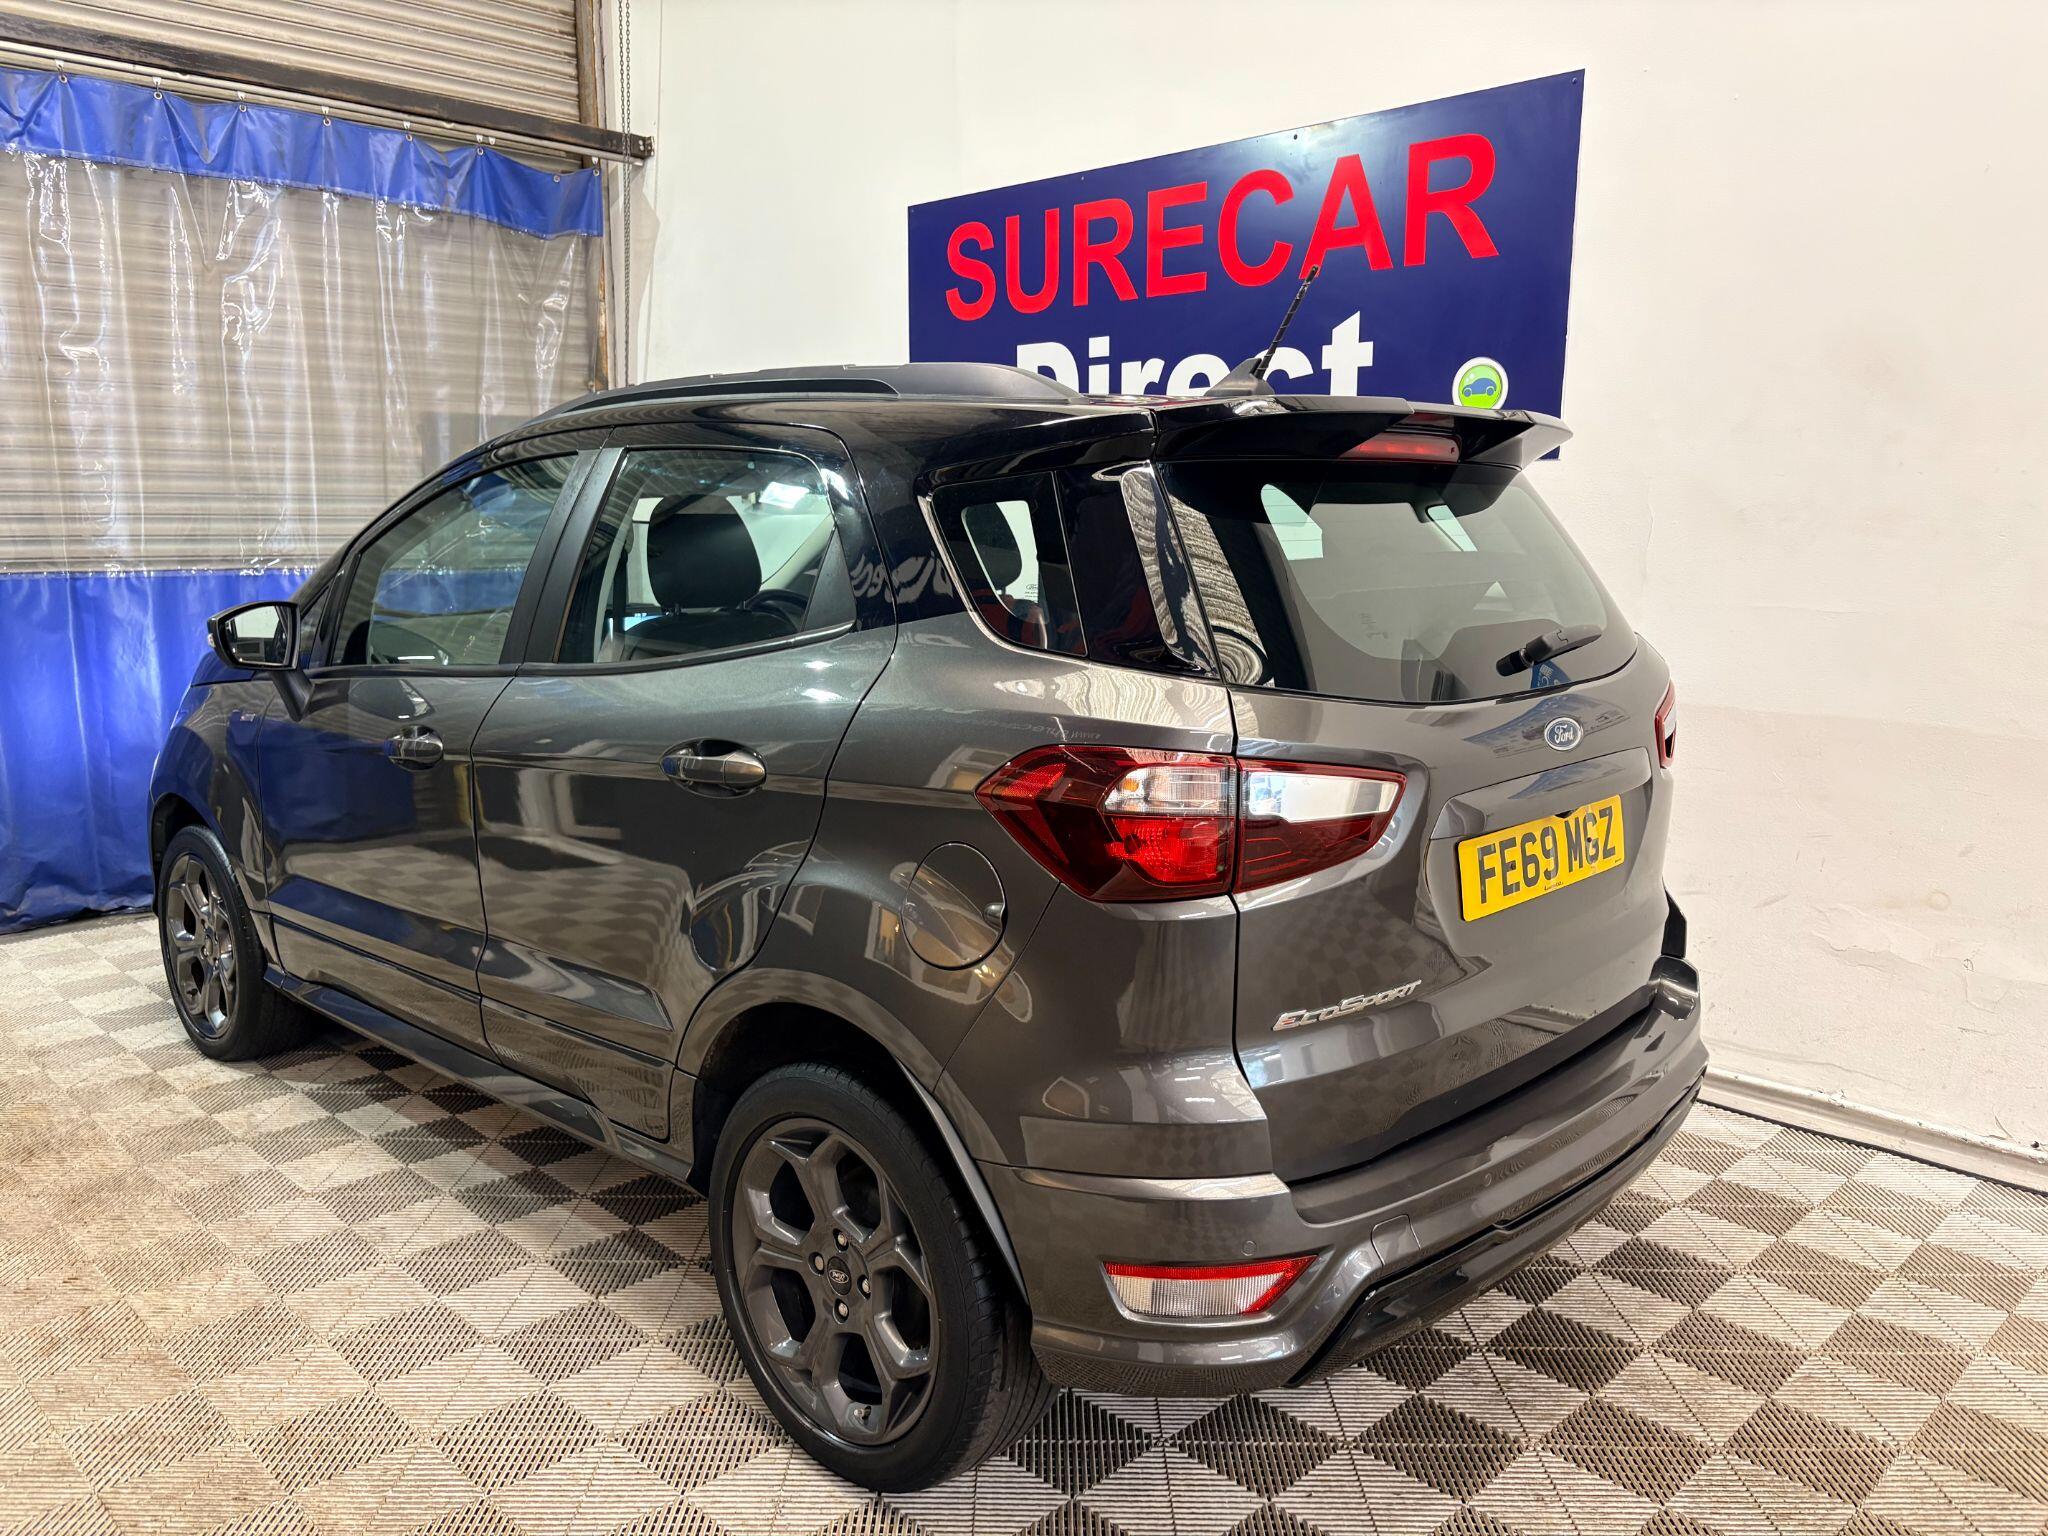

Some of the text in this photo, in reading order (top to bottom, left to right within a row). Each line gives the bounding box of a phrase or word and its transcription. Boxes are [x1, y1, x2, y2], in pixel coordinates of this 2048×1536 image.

[945, 132, 1500, 321] SURECAR
[1554, 723, 1575, 744] Ford
[1476, 805, 1617, 905] FE69 MGZ
[1270, 979, 1422, 1031] EcoSport
